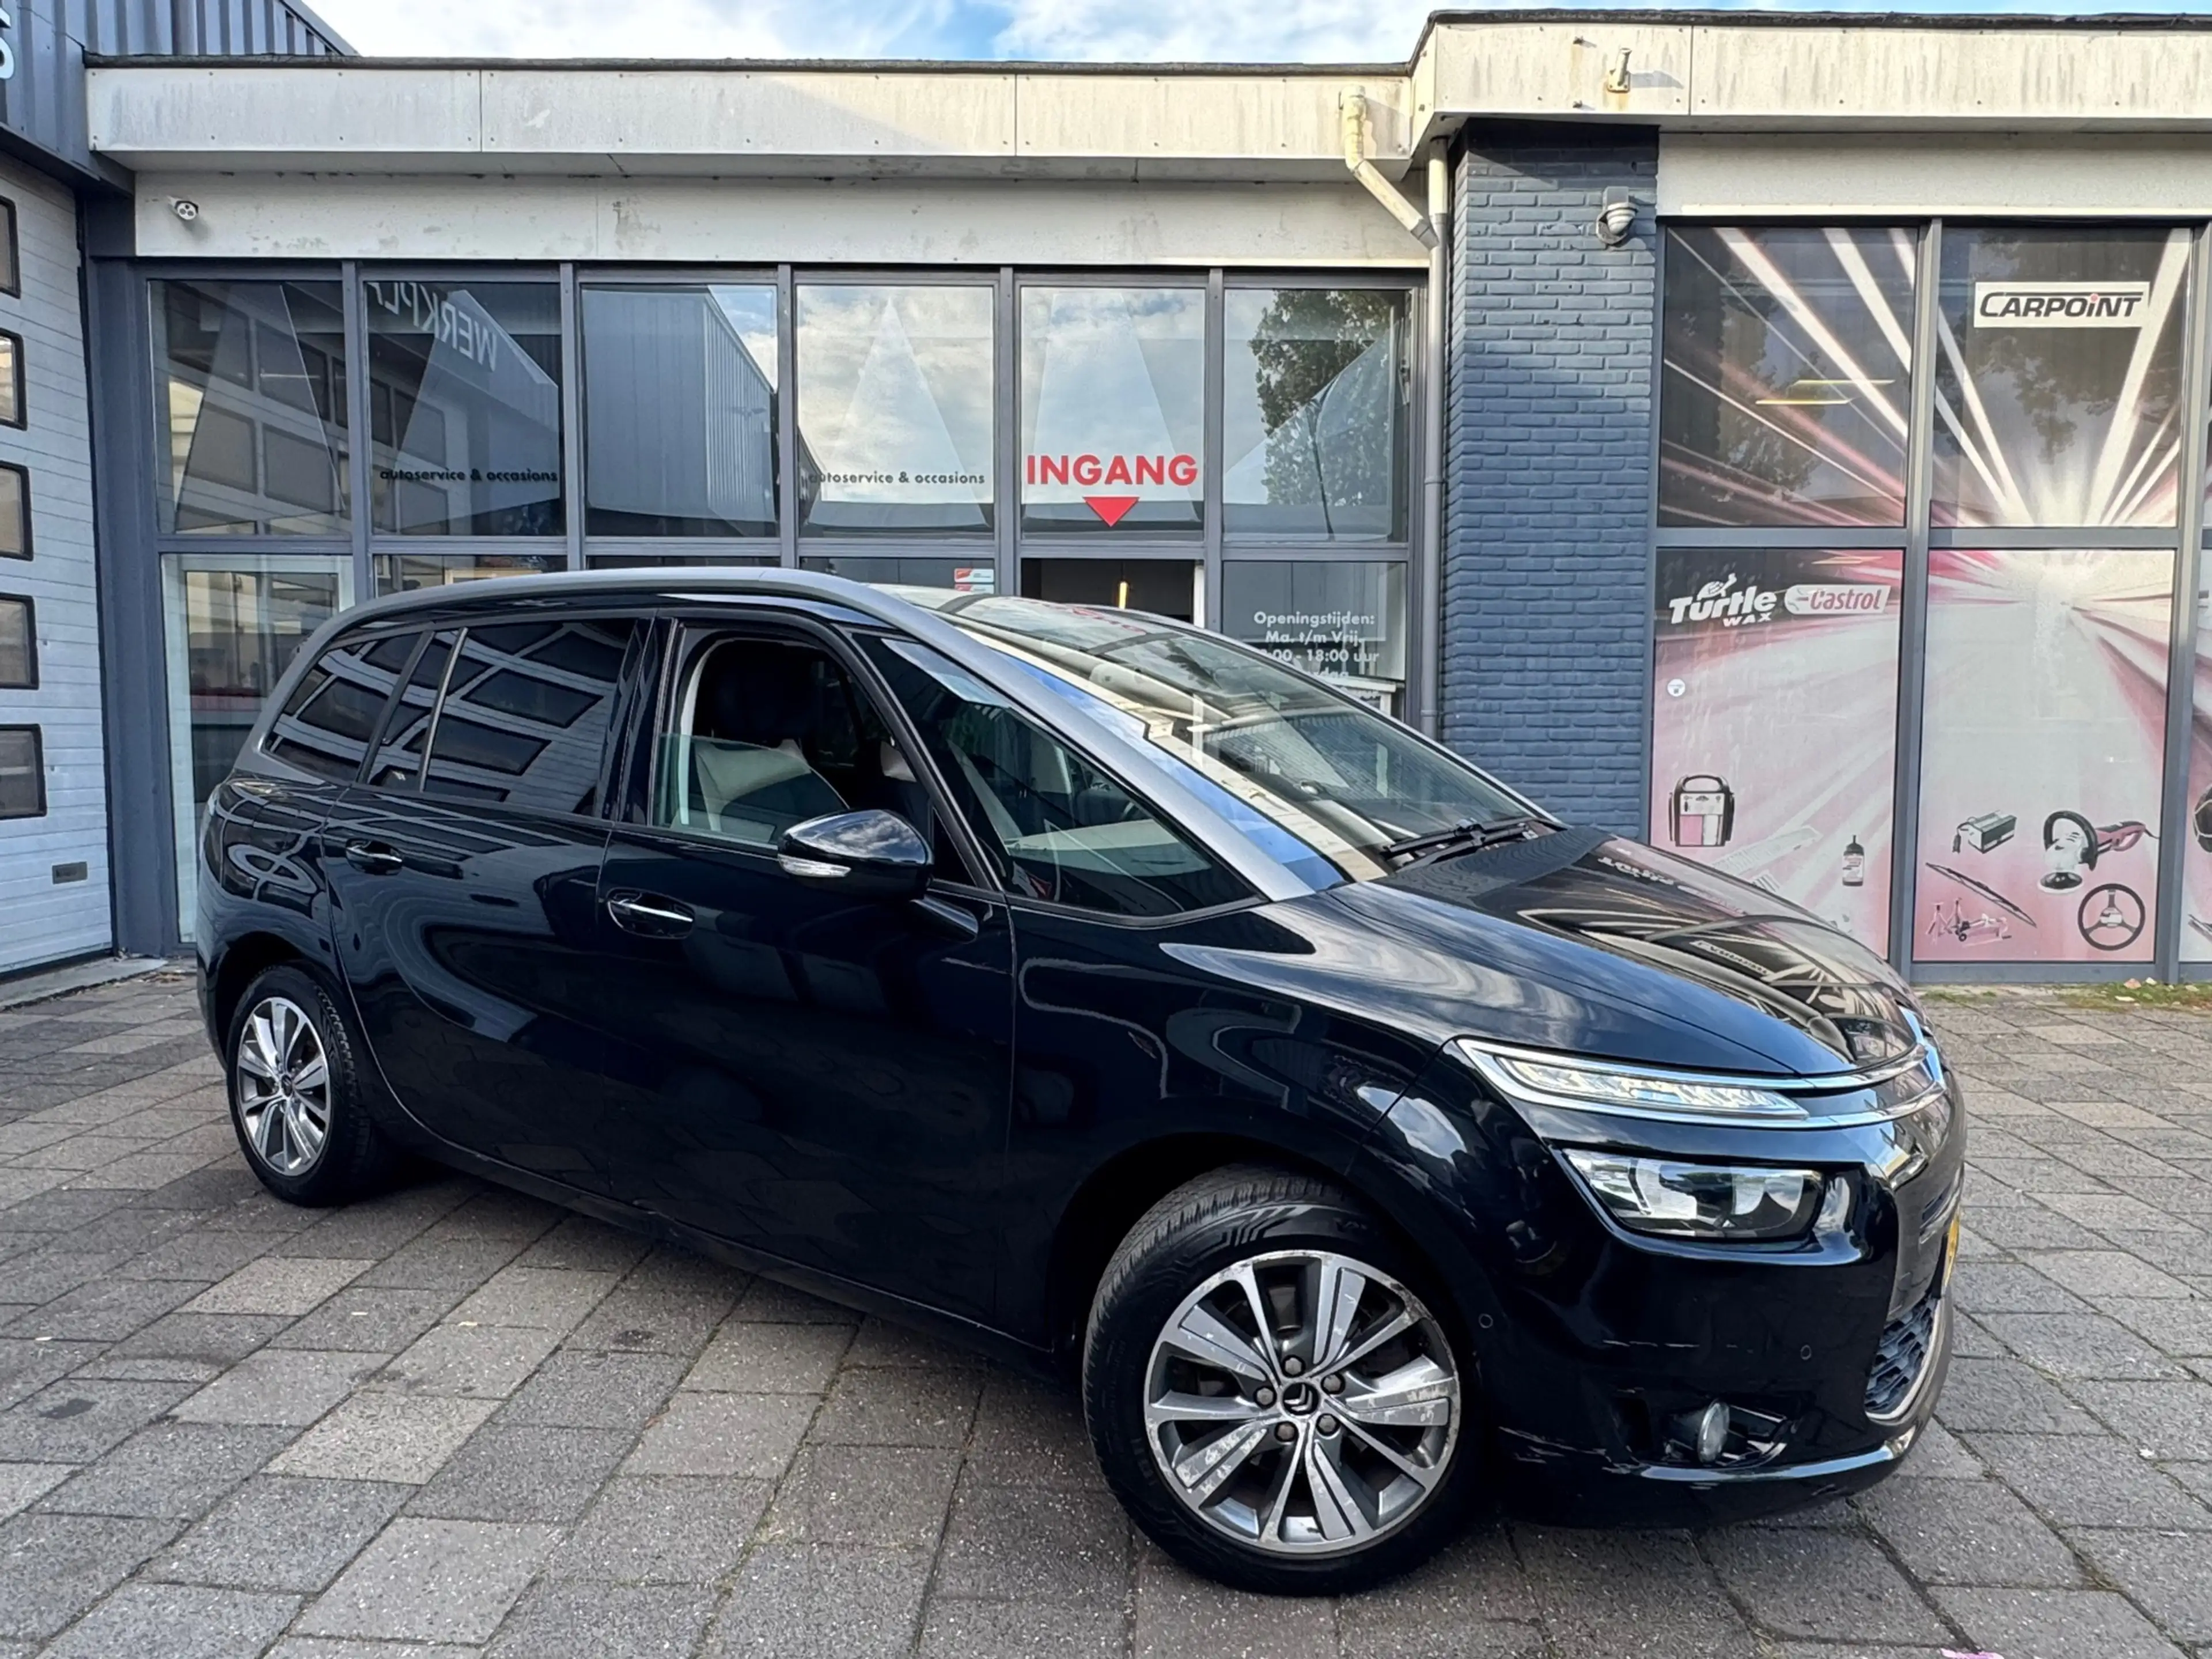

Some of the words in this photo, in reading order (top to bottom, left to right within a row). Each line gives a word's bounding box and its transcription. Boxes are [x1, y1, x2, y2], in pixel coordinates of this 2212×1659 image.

[380, 468, 465, 482] autoservice
[471, 468, 482, 482] &
[487, 468, 558, 482] occasions
[809, 471, 893, 484] autoservice
[899, 471, 910, 484] &
[915, 471, 985, 484] occasions
[1027, 454, 1198, 486] INGANG
[1669, 585, 1777, 624] Turtle
[1810, 588, 1881, 611] Castrol
[1253, 611, 1375, 627] Openingstijden:
[1266, 631, 1294, 643] Ma.
[1300, 630, 1326, 645] t/m
[1307, 649, 1349, 662] 18:00
[1354, 652, 1380, 662] uur
